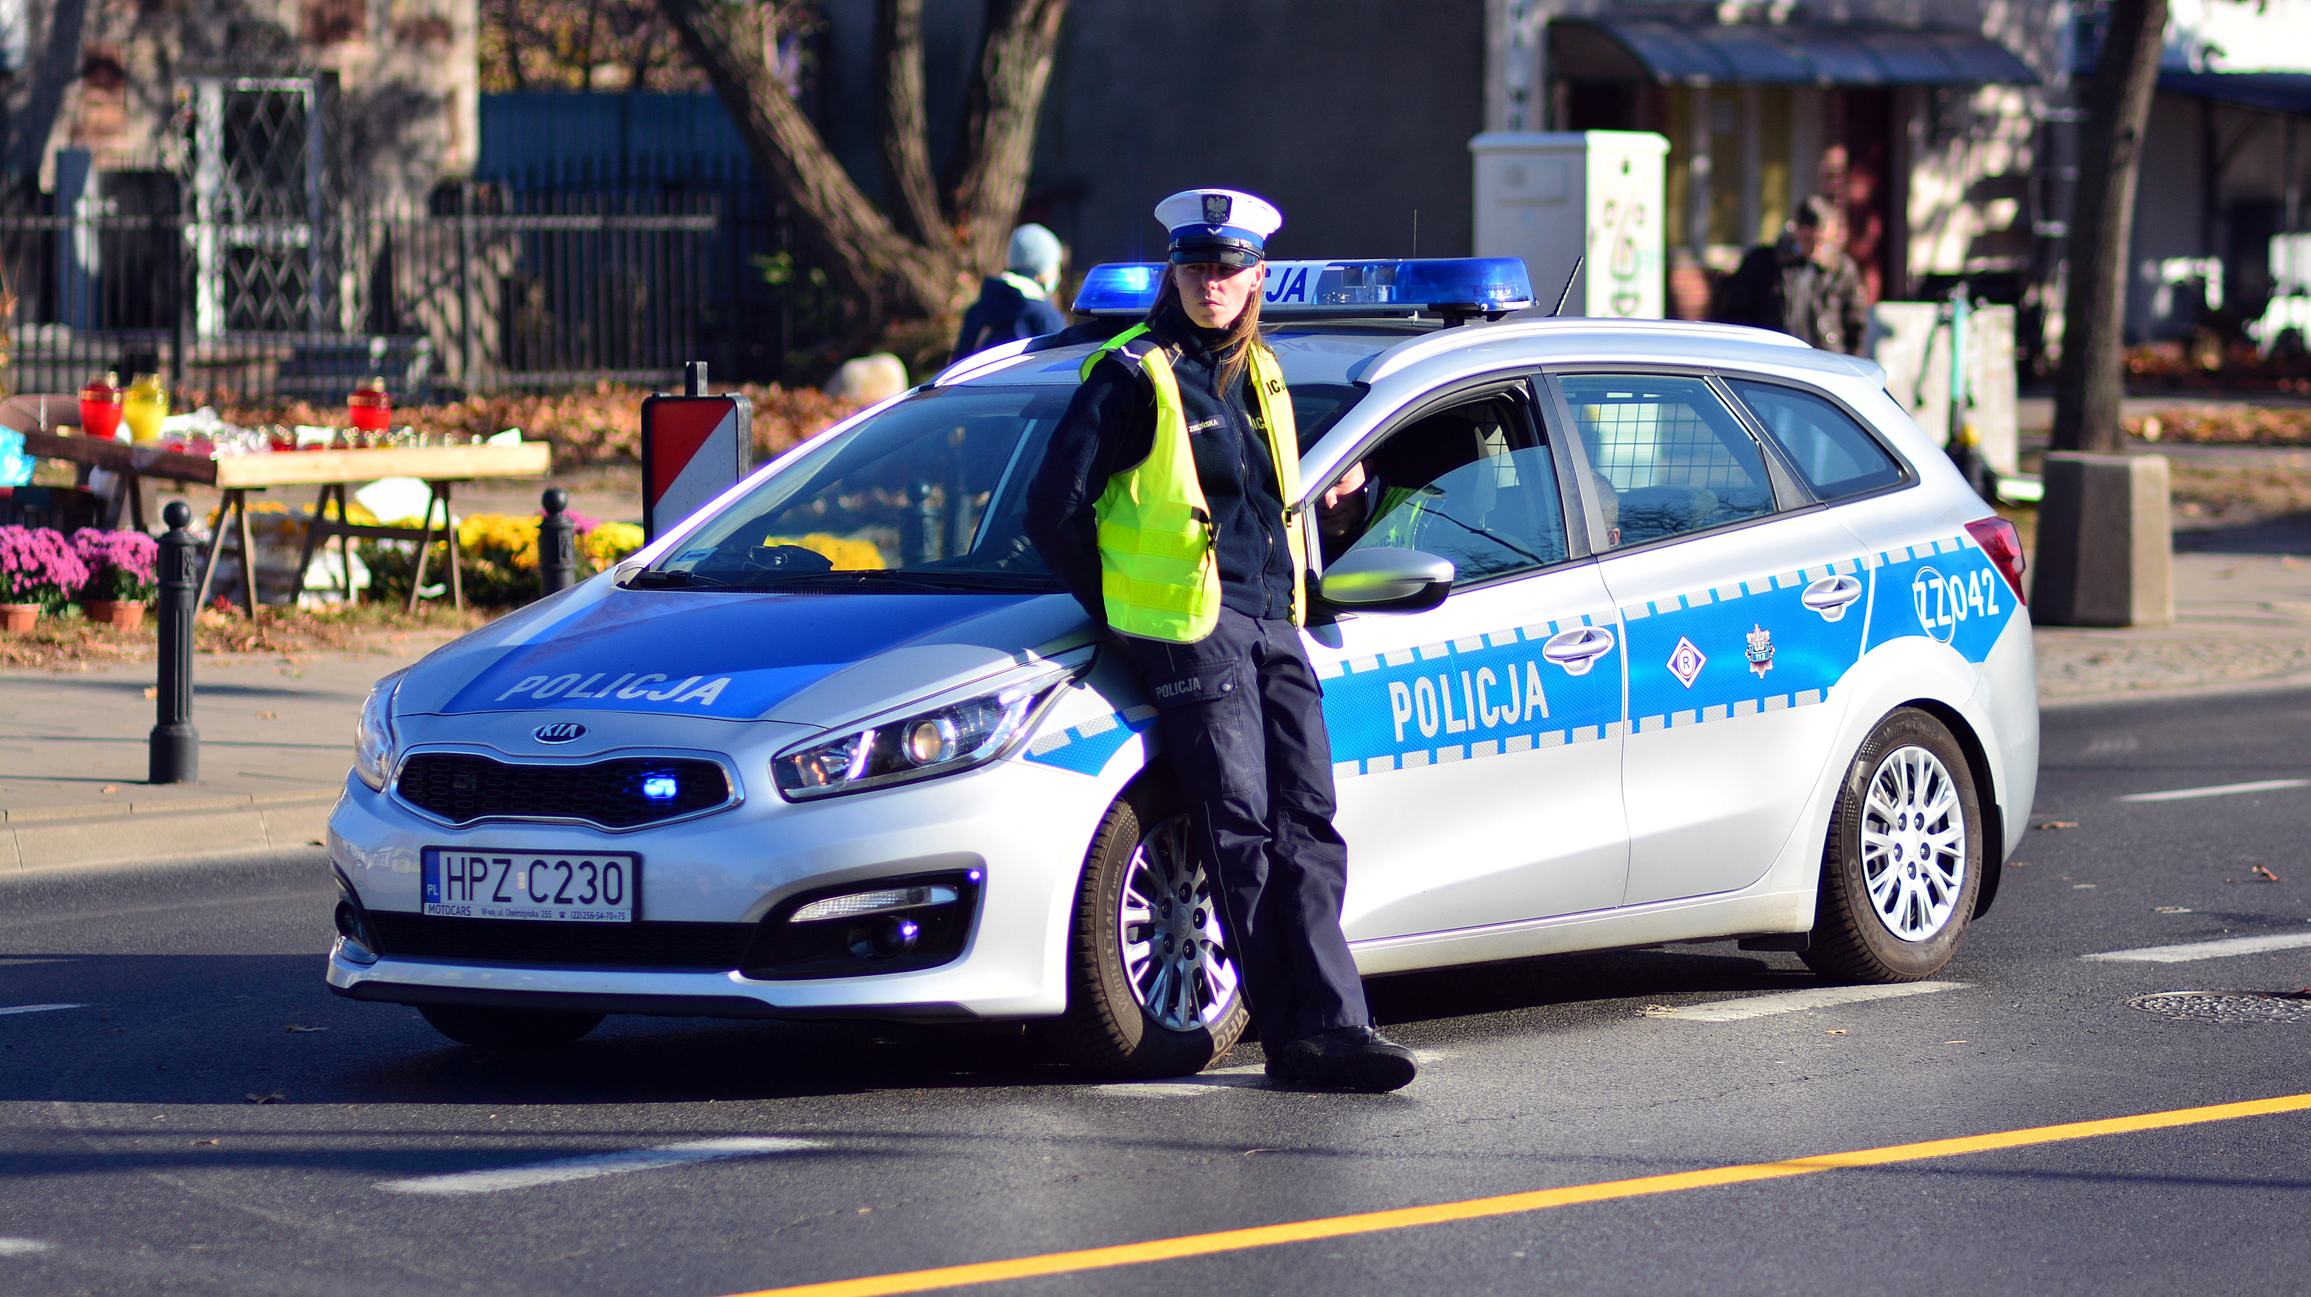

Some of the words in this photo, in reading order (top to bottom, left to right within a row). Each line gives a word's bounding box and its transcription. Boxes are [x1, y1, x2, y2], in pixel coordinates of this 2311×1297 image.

[1912, 568, 1999, 629] ZZ042
[1683, 656, 1691, 670] R
[495, 672, 732, 706] POLICJA
[1155, 677, 1202, 700] POLICJA
[1388, 661, 1550, 742] POLICJA
[539, 723, 578, 738] KIA
[427, 884, 439, 896] PL
[447, 857, 512, 903] HPZ
[528, 859, 623, 906] C230
[428, 904, 472, 917] MOTOCARS
[541, 910, 552, 919] 255
